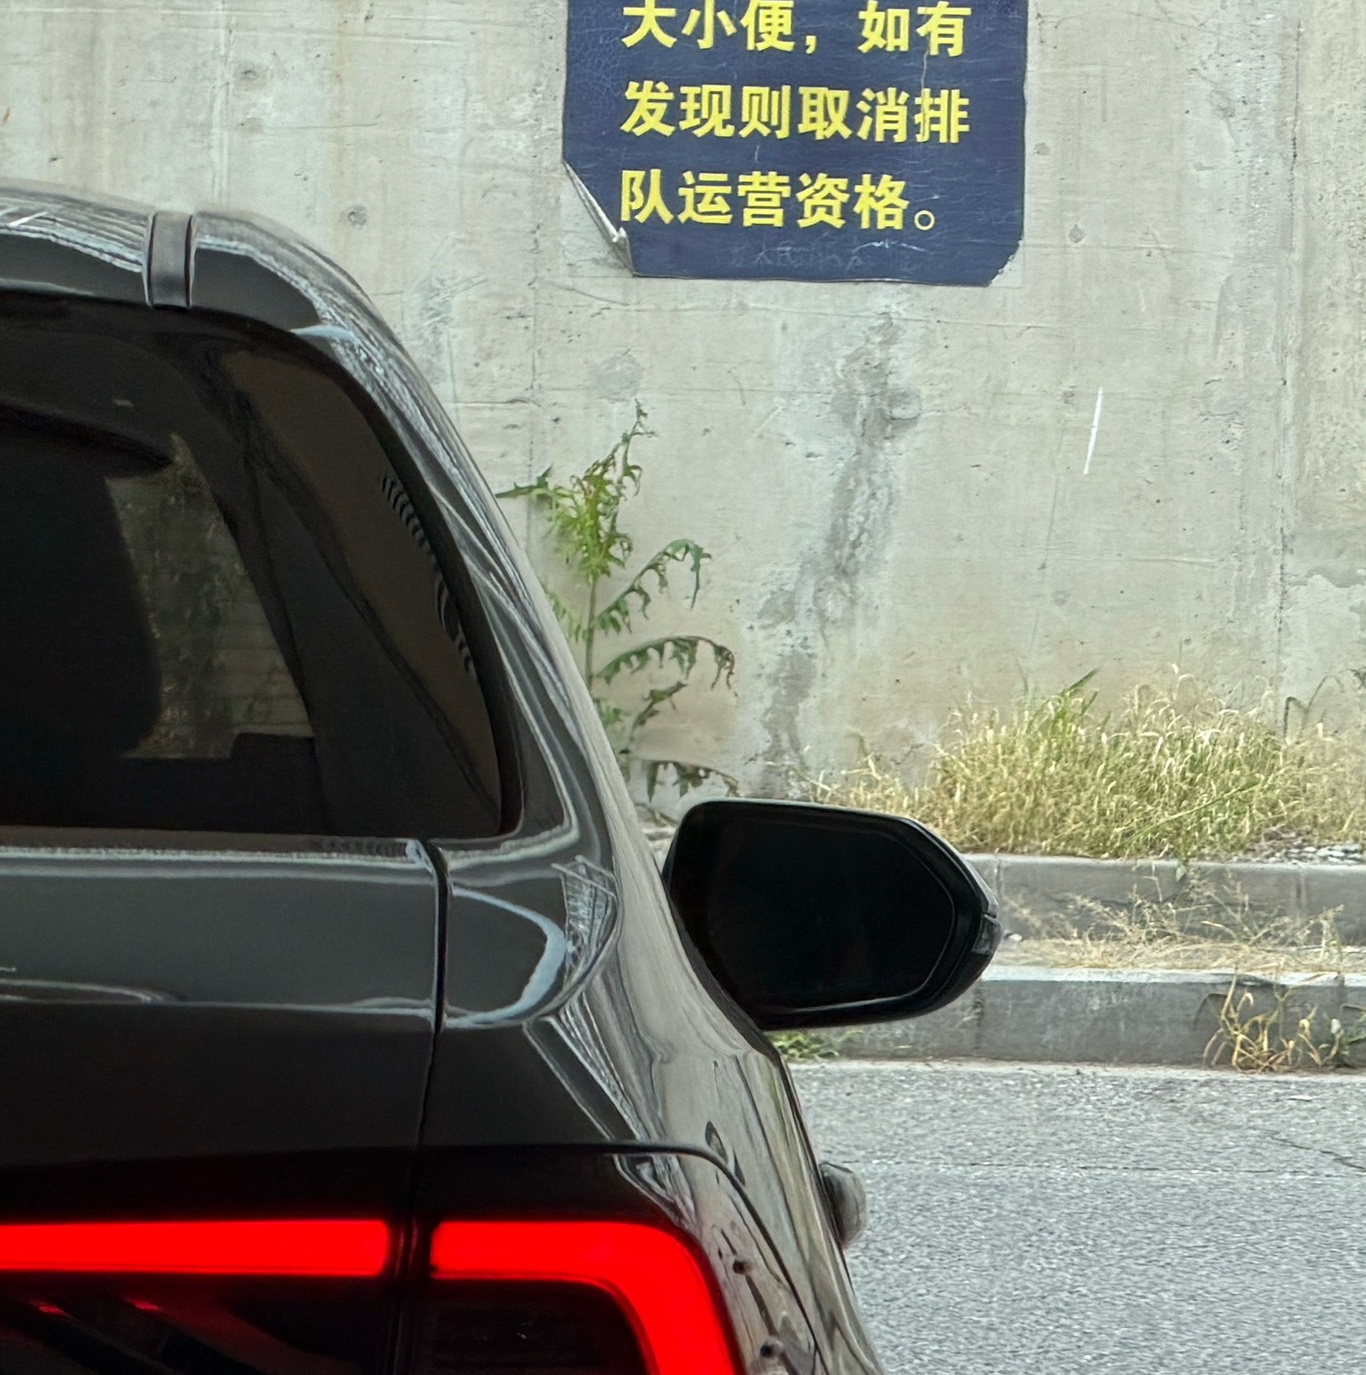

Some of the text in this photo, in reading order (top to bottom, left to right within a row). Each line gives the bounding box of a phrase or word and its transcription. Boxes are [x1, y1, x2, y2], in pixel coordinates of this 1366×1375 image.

[620, 80, 970, 143] 发现则取消排
[620, 169, 935, 232] 队运营资格。
